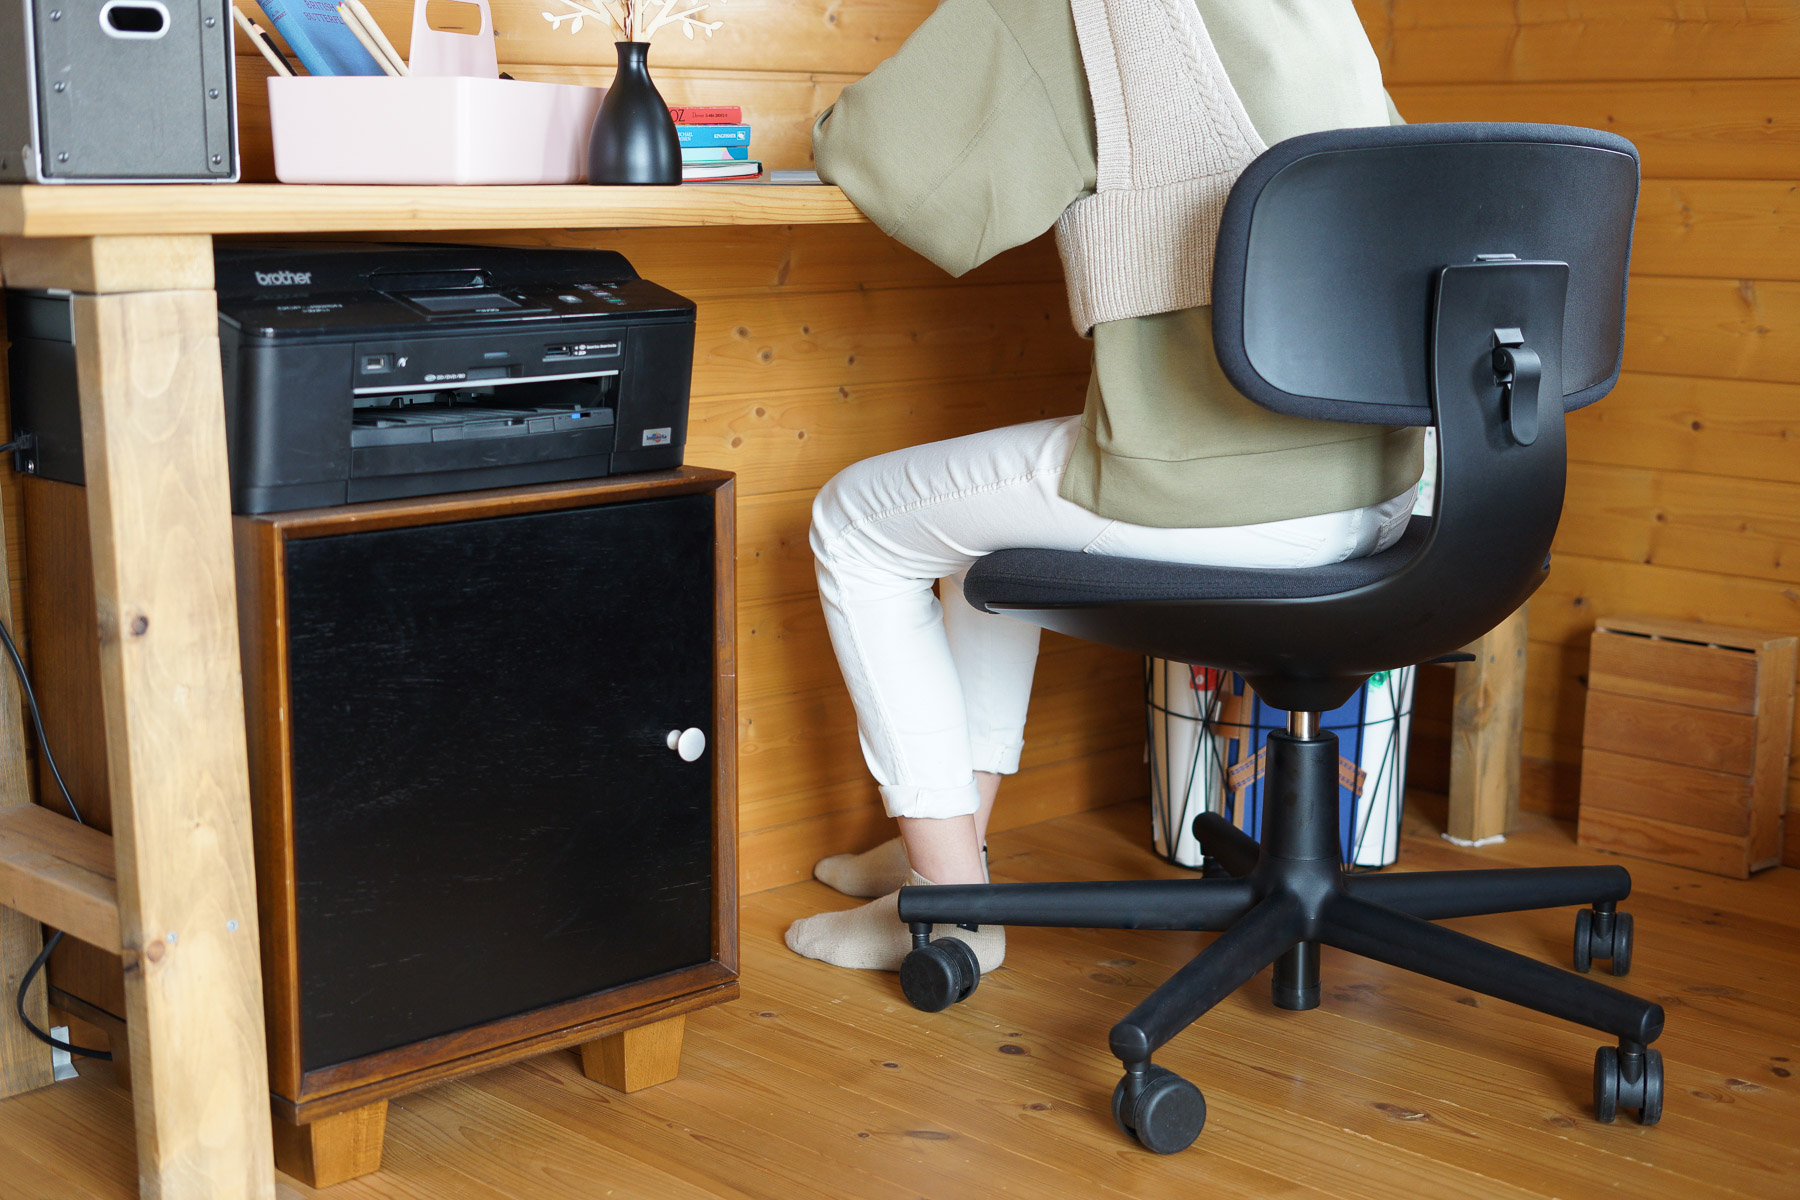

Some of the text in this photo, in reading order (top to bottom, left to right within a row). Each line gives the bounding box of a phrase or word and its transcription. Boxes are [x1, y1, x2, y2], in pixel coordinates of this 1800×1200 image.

[304, 0, 338, 12] BRITISH
[303, 12, 345, 25] BUTTERFL
[669, 109, 686, 123] OZ
[255, 270, 312, 286] brother
